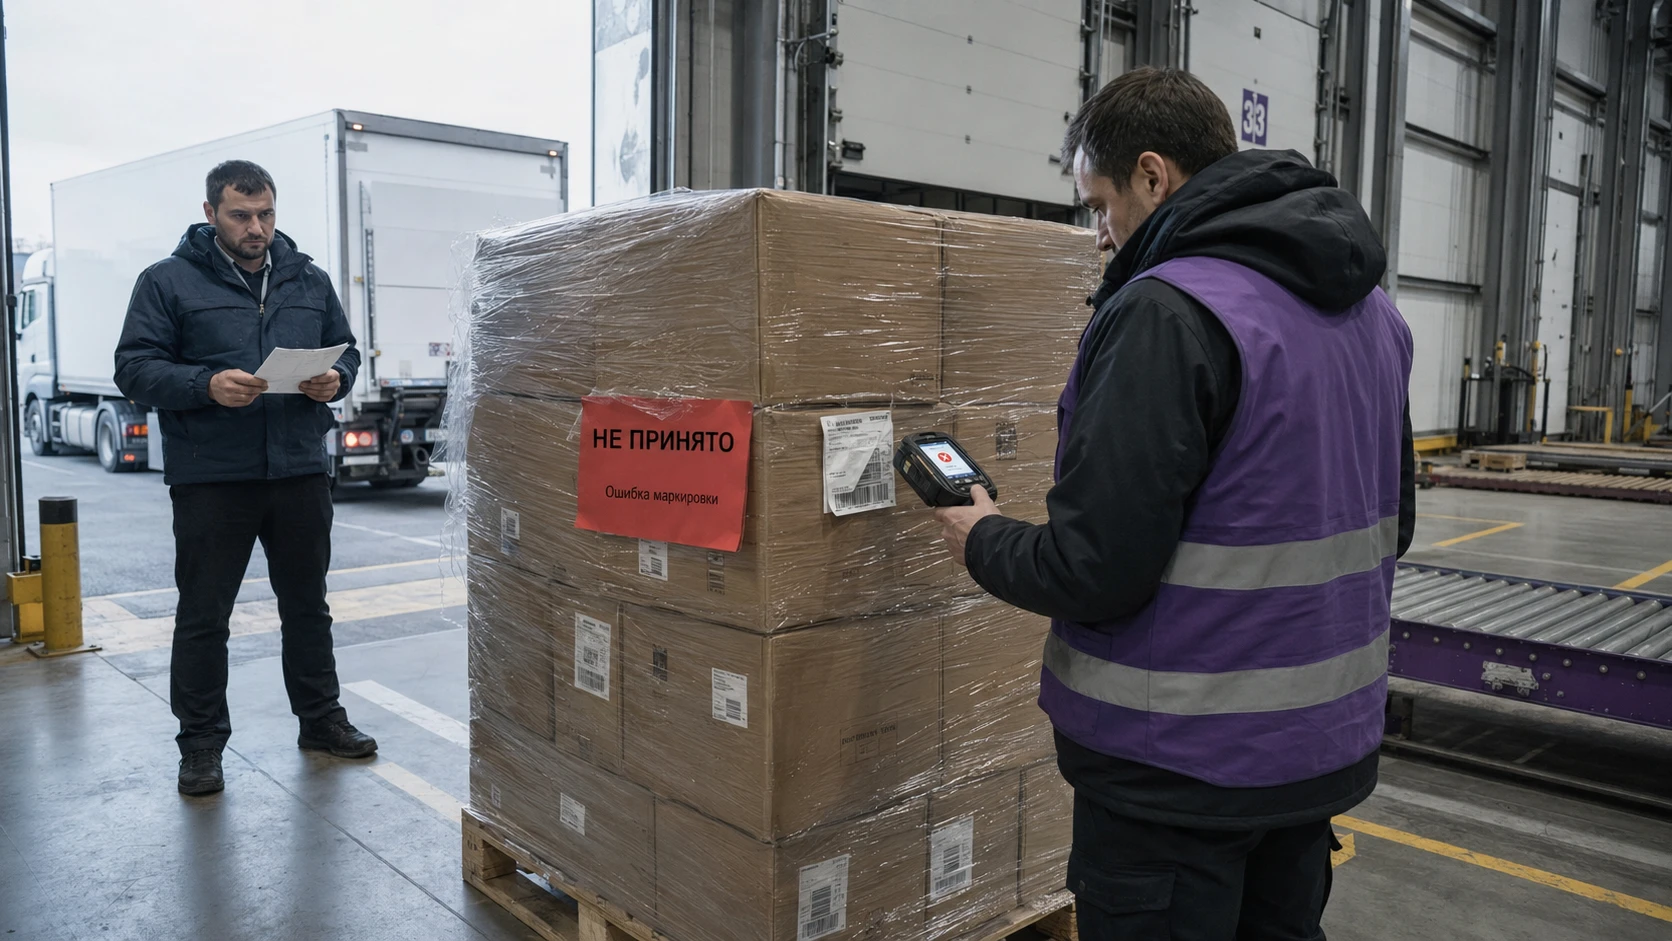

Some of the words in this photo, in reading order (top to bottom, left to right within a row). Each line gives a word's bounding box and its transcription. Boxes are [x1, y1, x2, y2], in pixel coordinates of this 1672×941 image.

[593, 428, 622, 450] НЕ
[630, 429, 734, 453] ПРИНЯТО
[605, 485, 650, 500] Ошибка
[653, 491, 718, 506] маркировки
